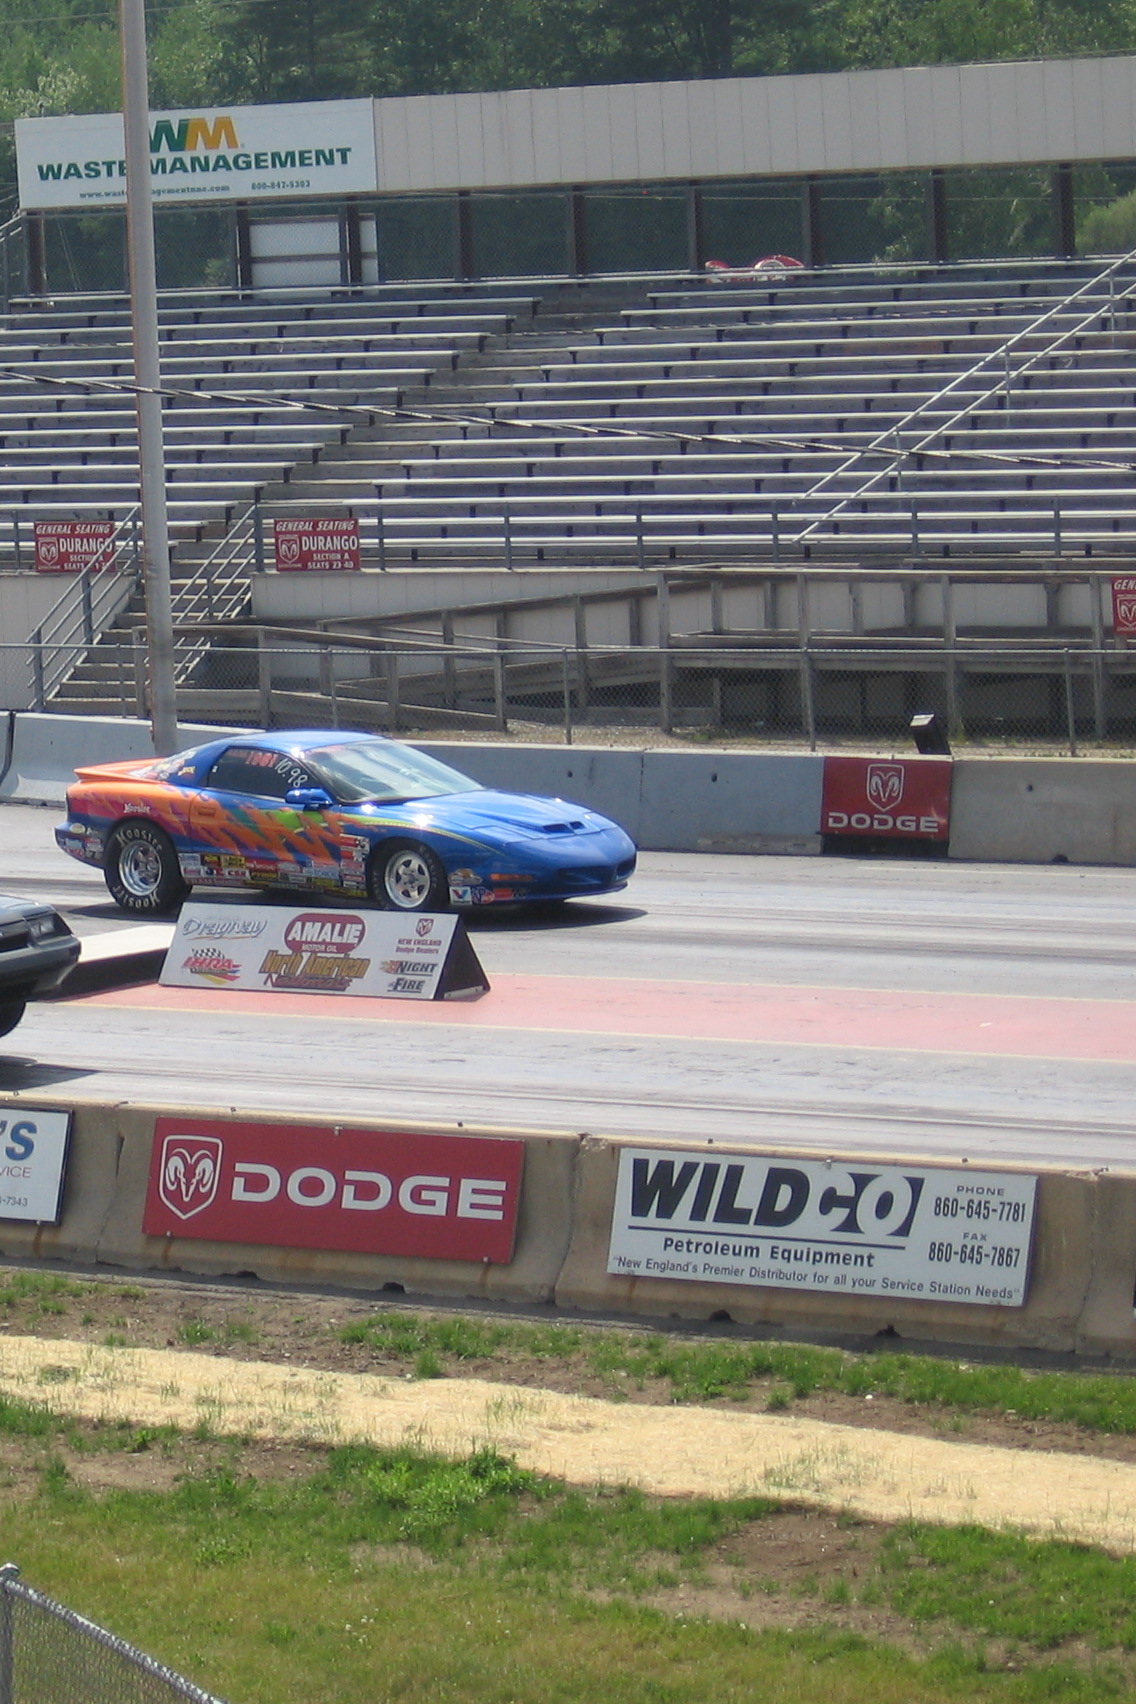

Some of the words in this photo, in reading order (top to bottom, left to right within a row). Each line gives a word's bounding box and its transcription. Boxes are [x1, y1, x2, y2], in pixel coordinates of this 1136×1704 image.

[150, 116, 239, 152] WM
[37, 159, 128, 181] WASTE
[150, 148, 351, 175] MANAGEMENT
[36, 524, 72, 534] GENERAL
[74, 524, 110, 534] SEATING
[276, 521, 313, 531] GENERAL
[316, 520, 354, 531] SEATING
[59, 537, 112, 552] DURANGO
[302, 535, 358, 550] DURANGO
[1114, 579, 1136, 590] GEN
[274, 757, 308, 788] 10.98
[828, 812, 939, 832] DODGE
[183, 918, 268, 938] Dragway
[286, 921, 363, 943] AMALIE
[396, 960, 438, 973] NIGHT
[392, 977, 426, 991] FIRE
[231, 1162, 507, 1221] DODGE
[631, 1157, 925, 1238] WILDCO
[956, 1185, 1006, 1197] PHONE
[934, 1196, 1026, 1222] 860-645-7781
[962, 1232, 988, 1241] FAX
[663, 1237, 761, 1258] Petroleum
[770, 1245, 876, 1268] Equipment
[928, 1241, 1021, 1268] 860-645-7867
[645, 1257, 699, 1273] England's
[702, 1263, 745, 1277] Premier
[749, 1266, 808, 1282] Distributor
[813, 1271, 829, 1284] for
[833, 1274, 847, 1286] all
[851, 1277, 876, 1290] your
[881, 1277, 924, 1292] Service
[929, 1281, 971, 1296] Station
